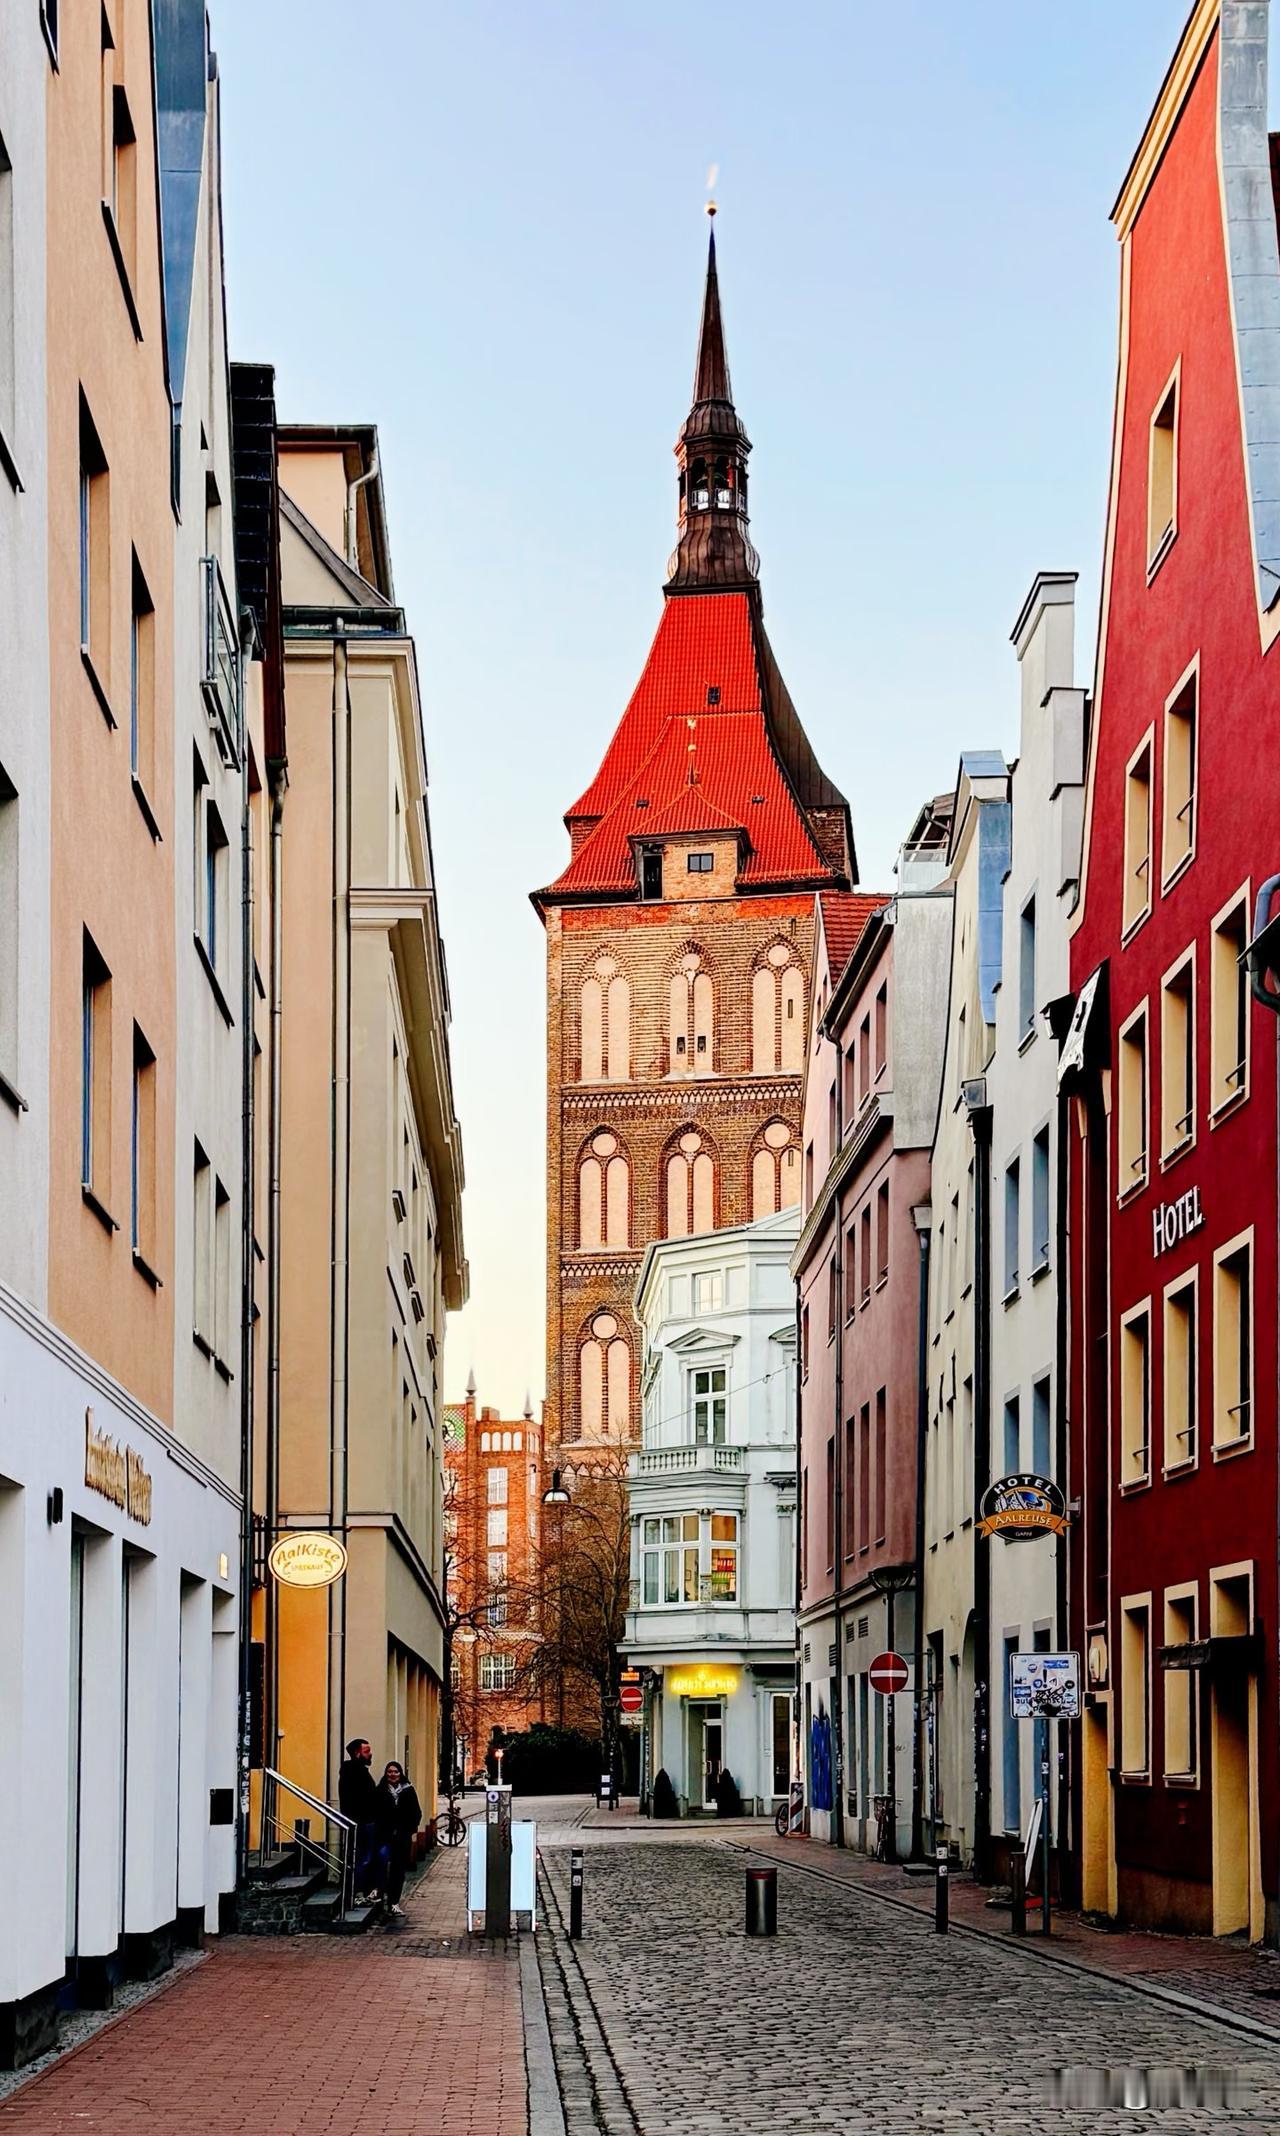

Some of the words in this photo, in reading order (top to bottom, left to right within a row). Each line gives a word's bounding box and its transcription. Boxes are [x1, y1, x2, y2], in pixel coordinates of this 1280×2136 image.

[1152, 1184, 1202, 1258] HOTEL
[993, 1476, 1052, 1495] HOTEL
[995, 1514, 1052, 1526] AALREUSE
